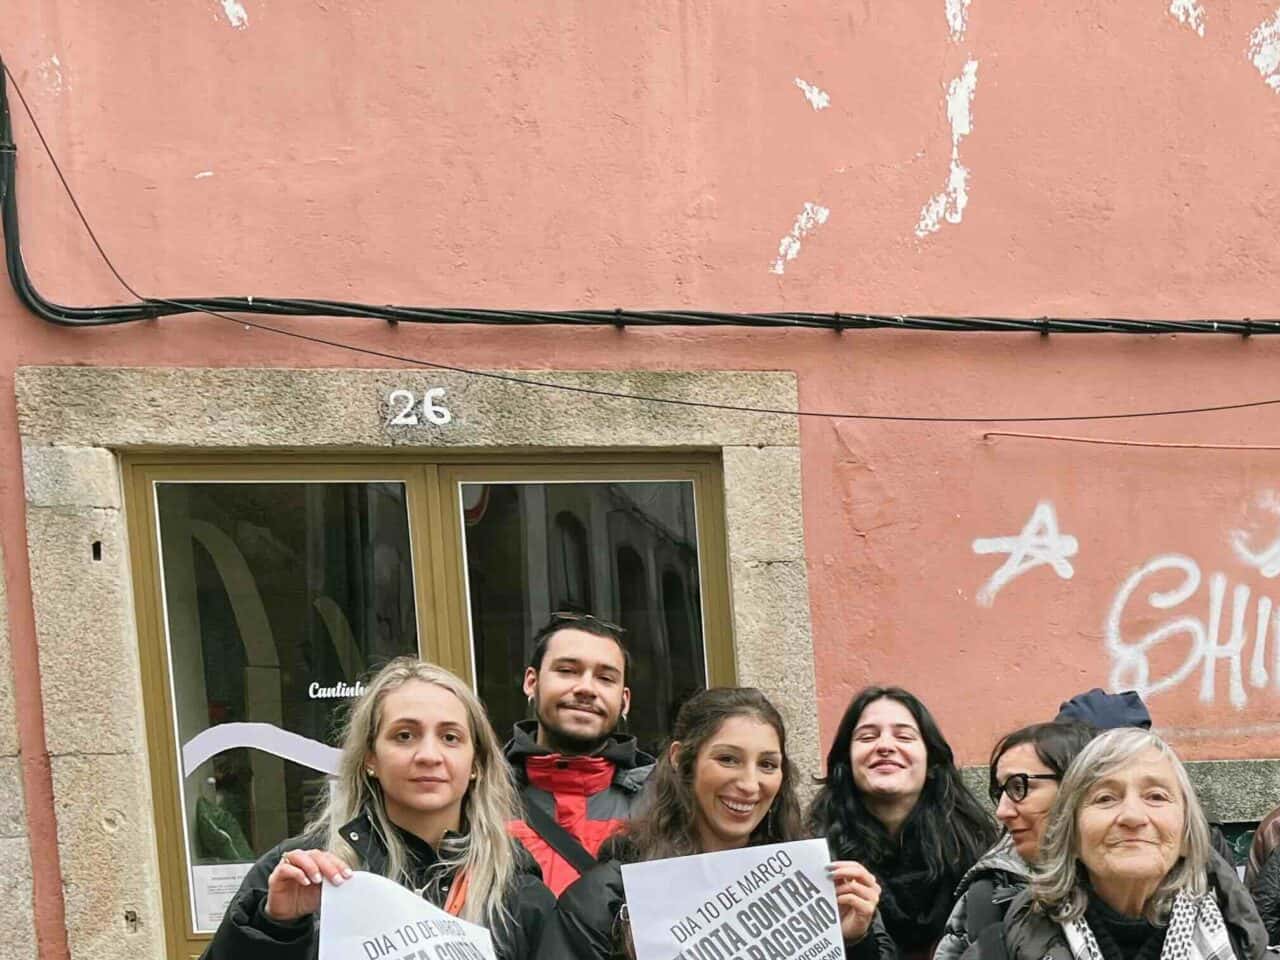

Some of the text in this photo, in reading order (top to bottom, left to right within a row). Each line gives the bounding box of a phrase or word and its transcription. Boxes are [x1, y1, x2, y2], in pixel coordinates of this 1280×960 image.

[388, 387, 452, 426] 26
[670, 850, 793, 944] DIA 10 DE MARÇO
[736, 869, 821, 939] CONTRA
[362, 934, 397, 960] DIA
[395, 925, 419, 947] 10
[416, 921, 438, 939] DE
